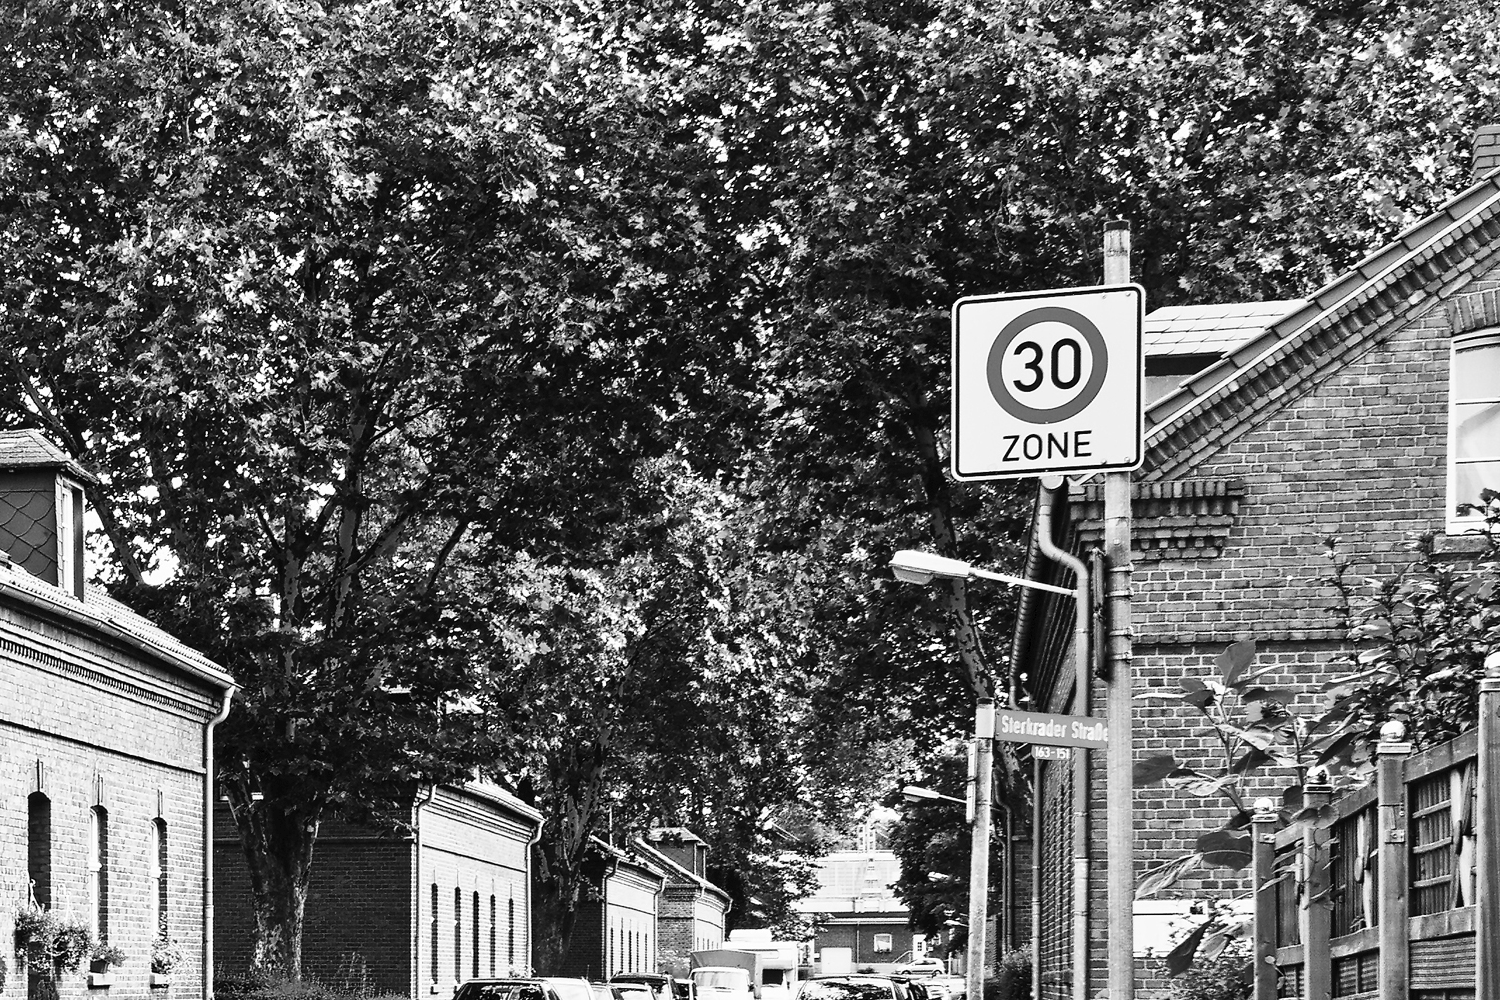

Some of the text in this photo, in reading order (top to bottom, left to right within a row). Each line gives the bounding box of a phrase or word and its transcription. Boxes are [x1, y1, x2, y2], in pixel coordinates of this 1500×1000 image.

[1013, 338, 1081, 392] 30
[1002, 430, 1092, 462] ZONE
[1001, 714, 1067, 738] Sterkrader
